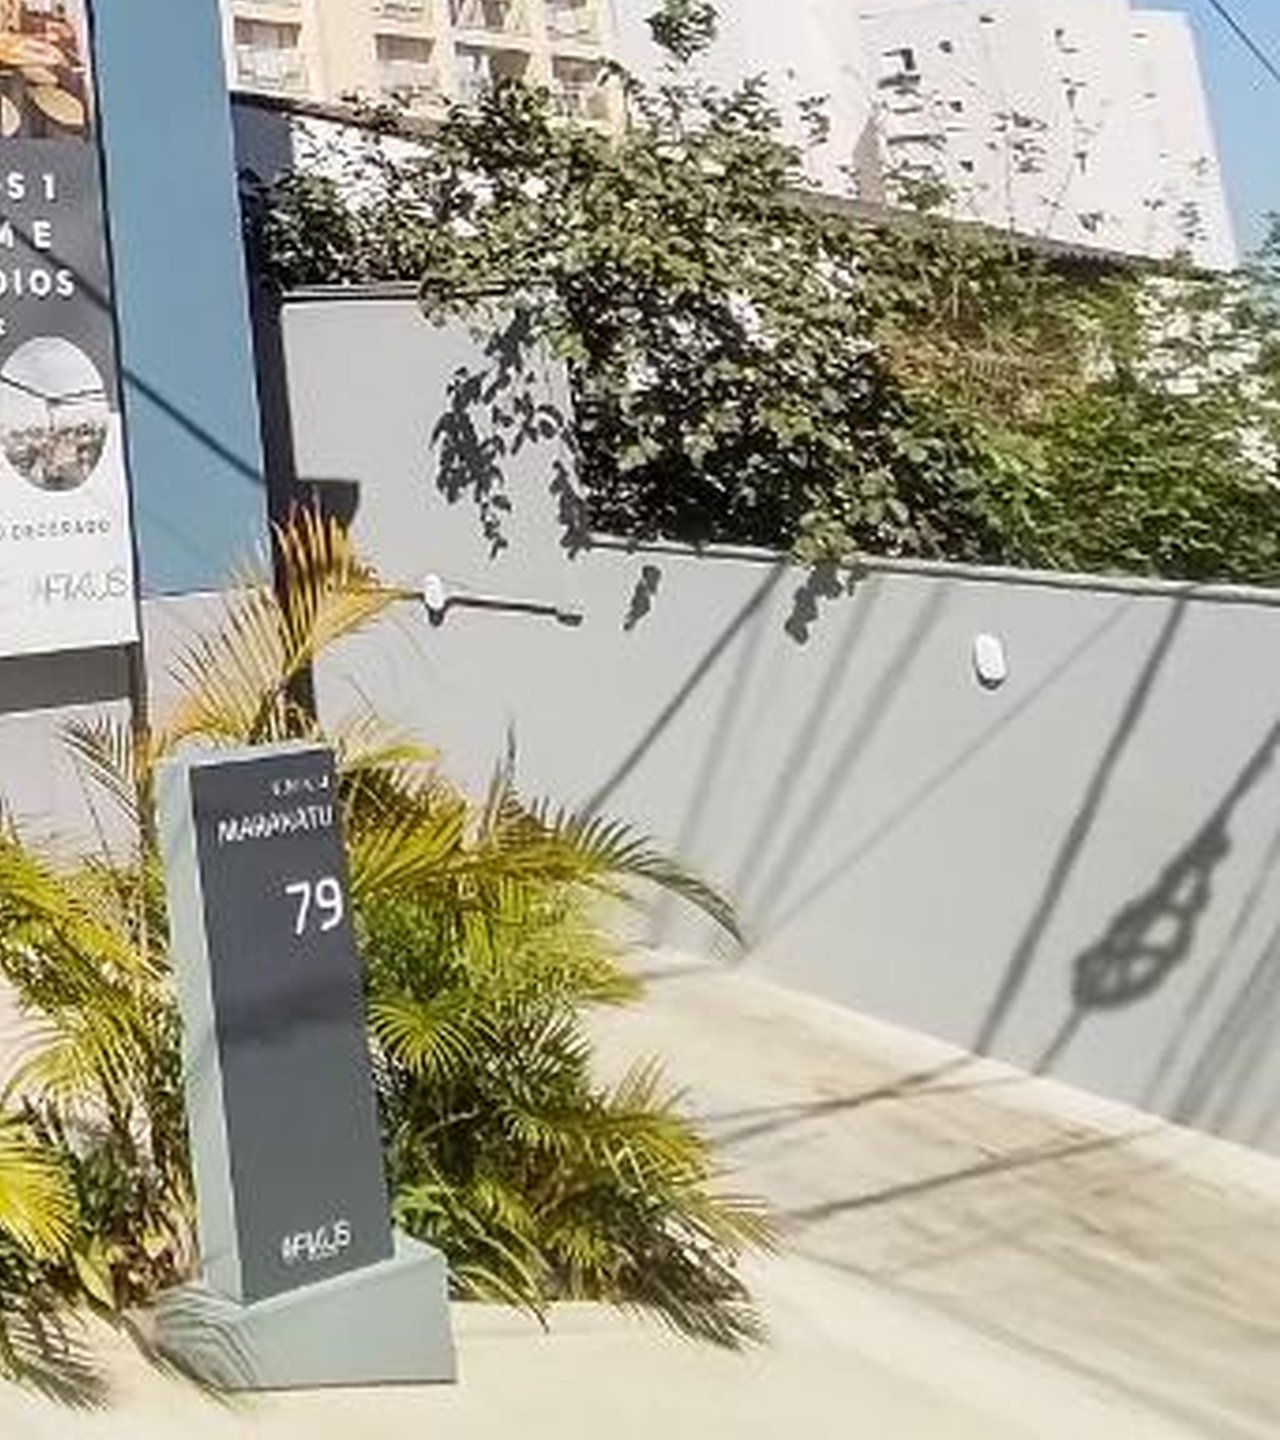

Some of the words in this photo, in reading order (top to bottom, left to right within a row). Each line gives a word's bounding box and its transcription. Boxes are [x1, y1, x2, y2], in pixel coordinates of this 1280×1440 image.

[42, 174, 57, 201] 1
[34, 220, 53, 249] E
[218, 806, 333, 844] MARAKATU
[285, 877, 343, 935] 79
